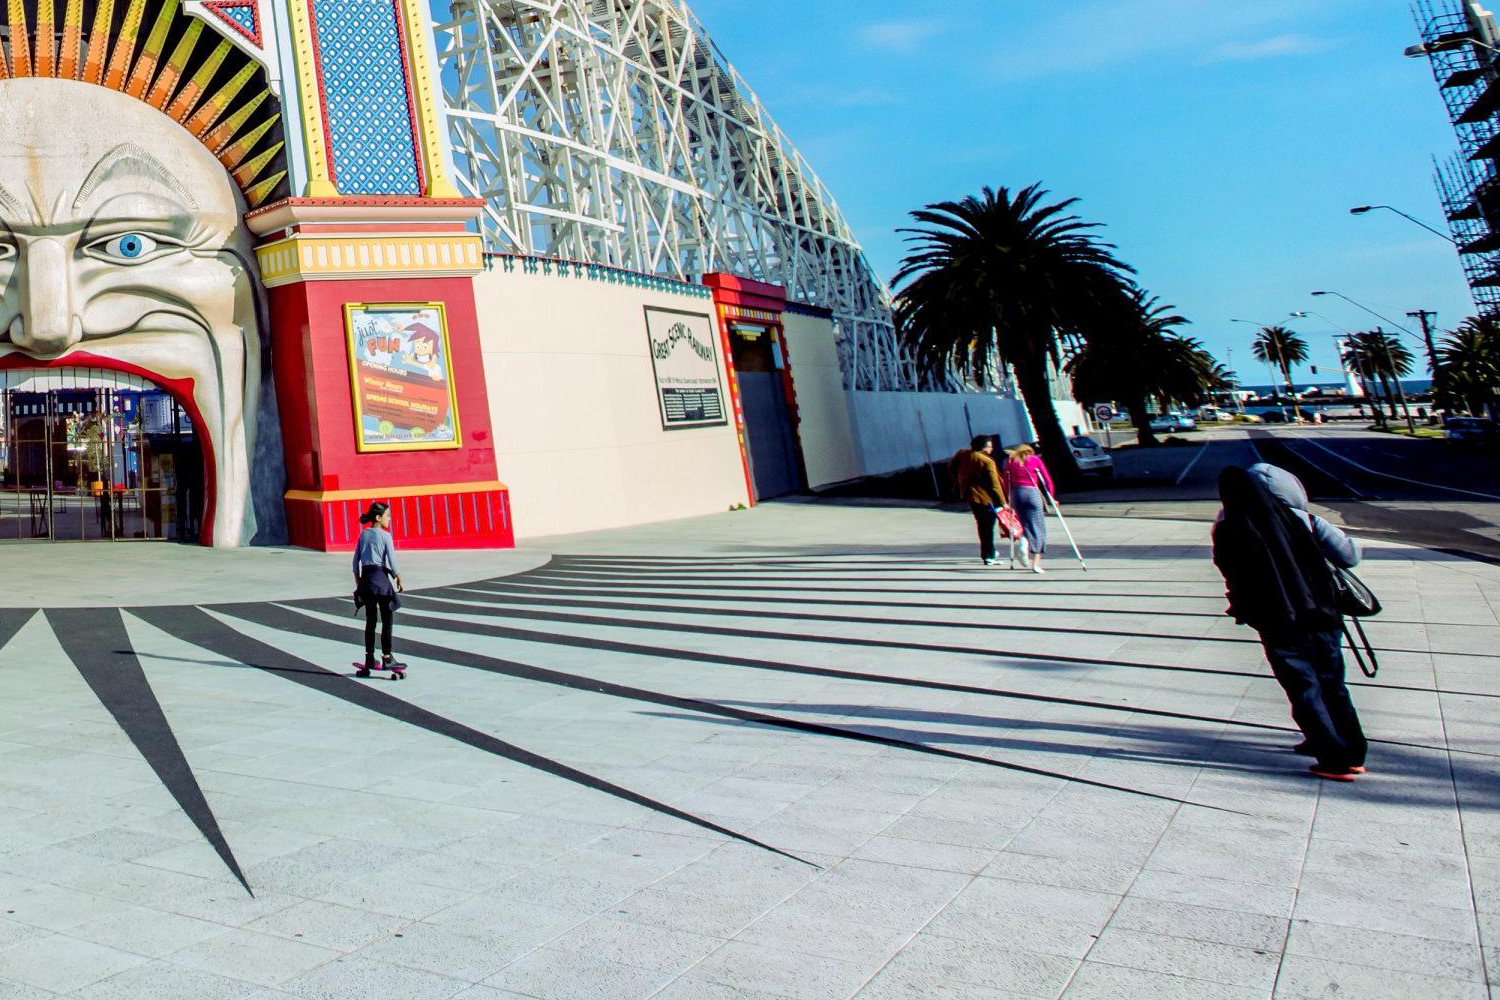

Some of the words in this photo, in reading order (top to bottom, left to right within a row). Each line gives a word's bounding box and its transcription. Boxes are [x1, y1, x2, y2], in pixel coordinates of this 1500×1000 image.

[366, 336, 400, 355] FUN
[653, 338, 670, 359] GREAT
[668, 321, 687, 349] SCENIC
[687, 327, 713, 361] RAILWAY
